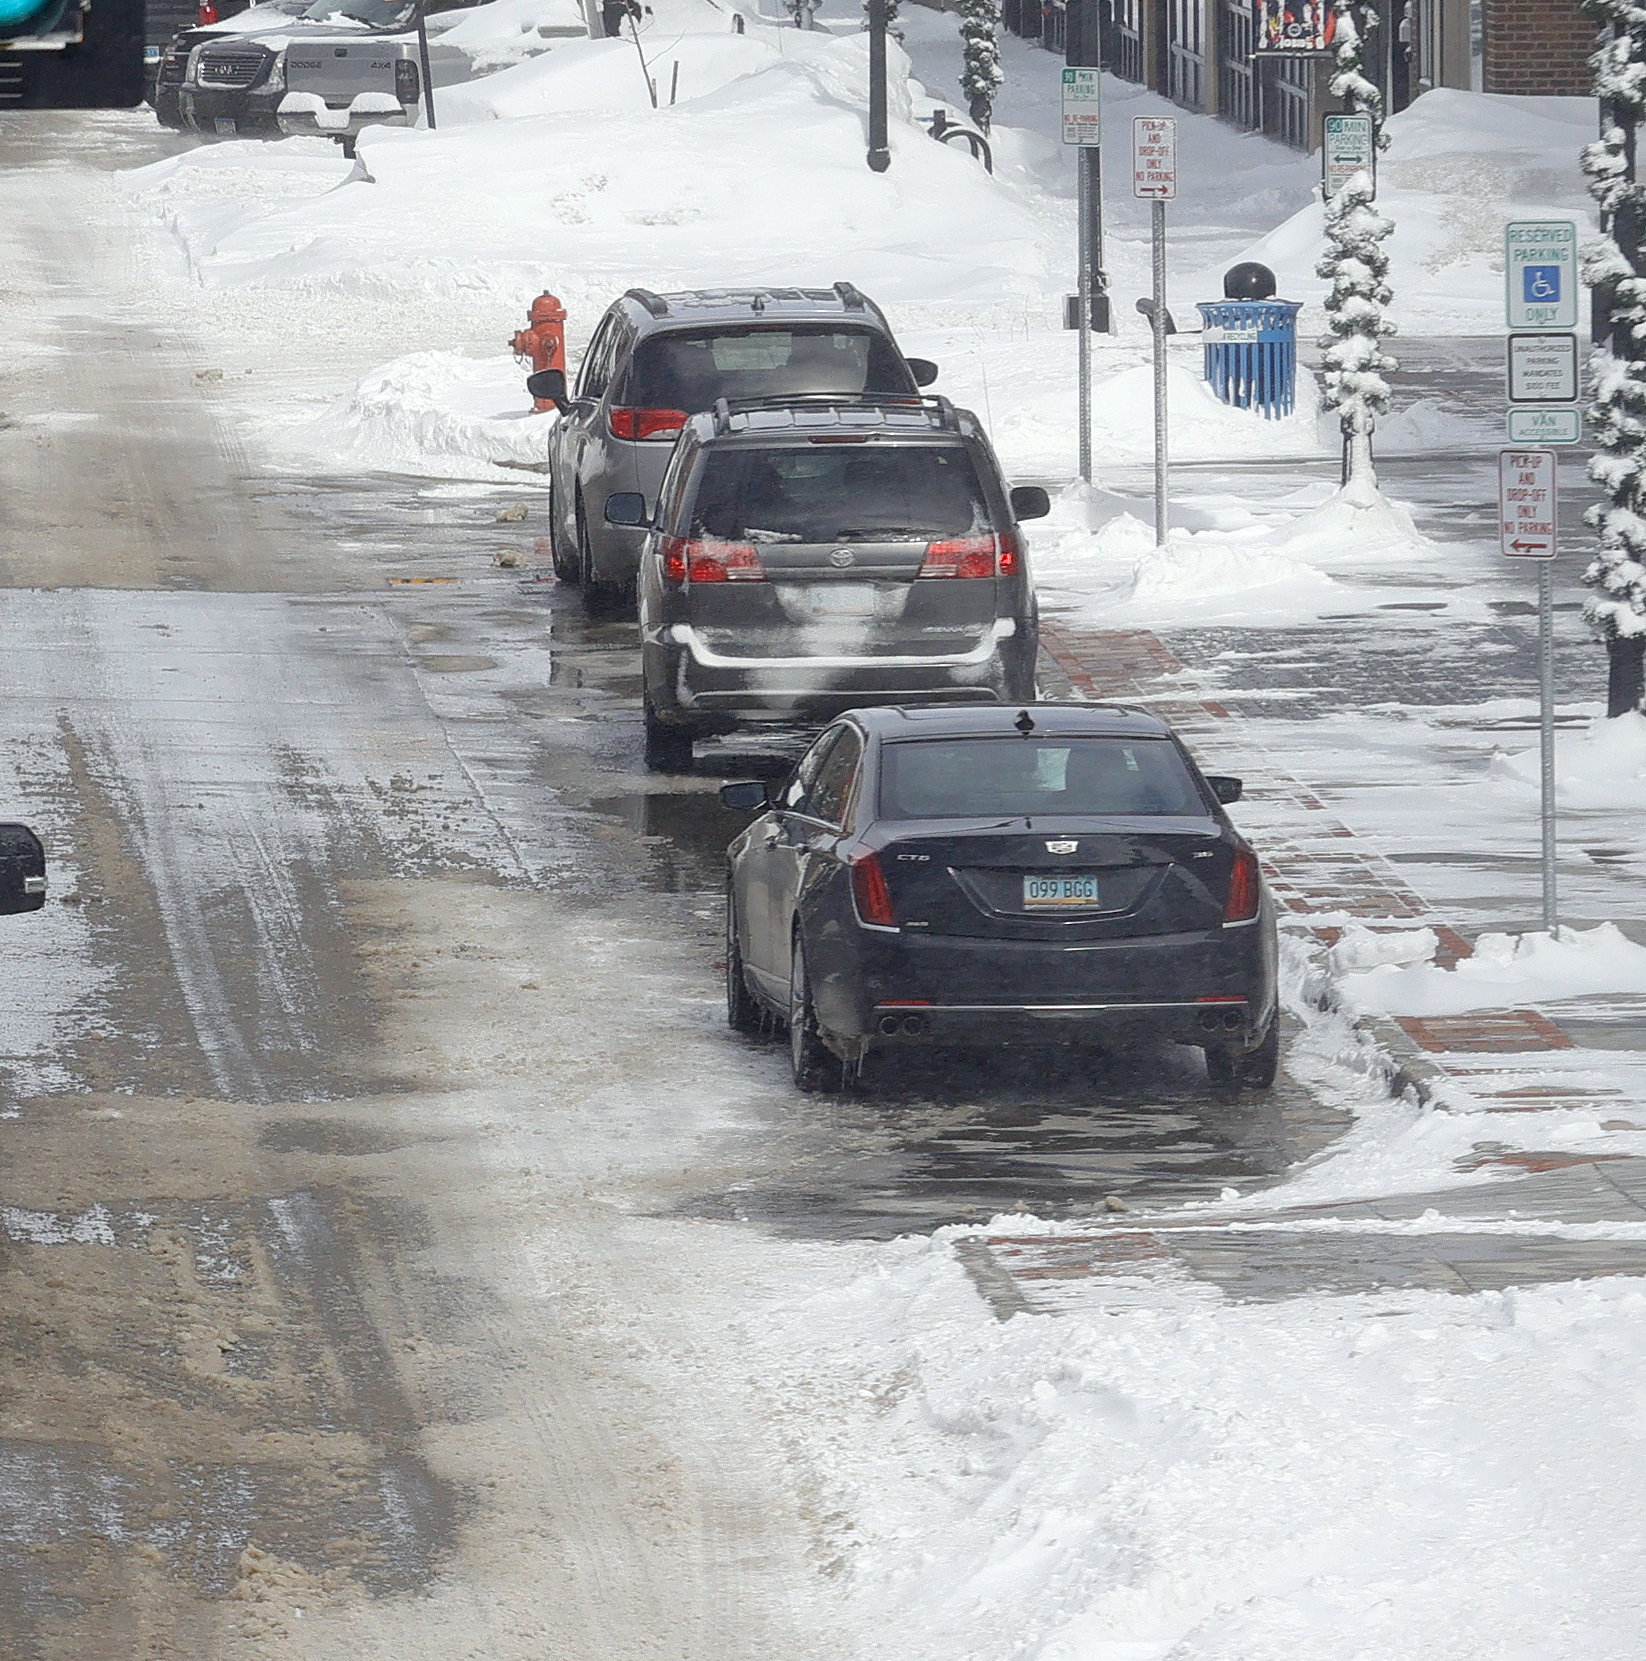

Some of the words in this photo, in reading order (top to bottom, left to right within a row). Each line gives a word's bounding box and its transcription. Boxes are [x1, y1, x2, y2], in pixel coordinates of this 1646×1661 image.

[1344, 121, 1367, 132] MIN
[1509, 229, 1573, 243] RESERVED
[1514, 247, 1569, 261] PARKING
[1525, 307, 1559, 321] ONLY
[1532, 416, 1557, 426] VAN
[1519, 427, 1569, 436] ACCESSIBLE
[1519, 472, 1535, 485] AND
[1507, 488, 1547, 501] DROP-OFF
[1517, 505, 1537, 518] ONLY
[1504, 521, 1514, 534] NO
[1518, 522, 1553, 535] PARKING
[1029, 881, 1058, 899] 099
[1063, 881, 1093, 898] BGG
